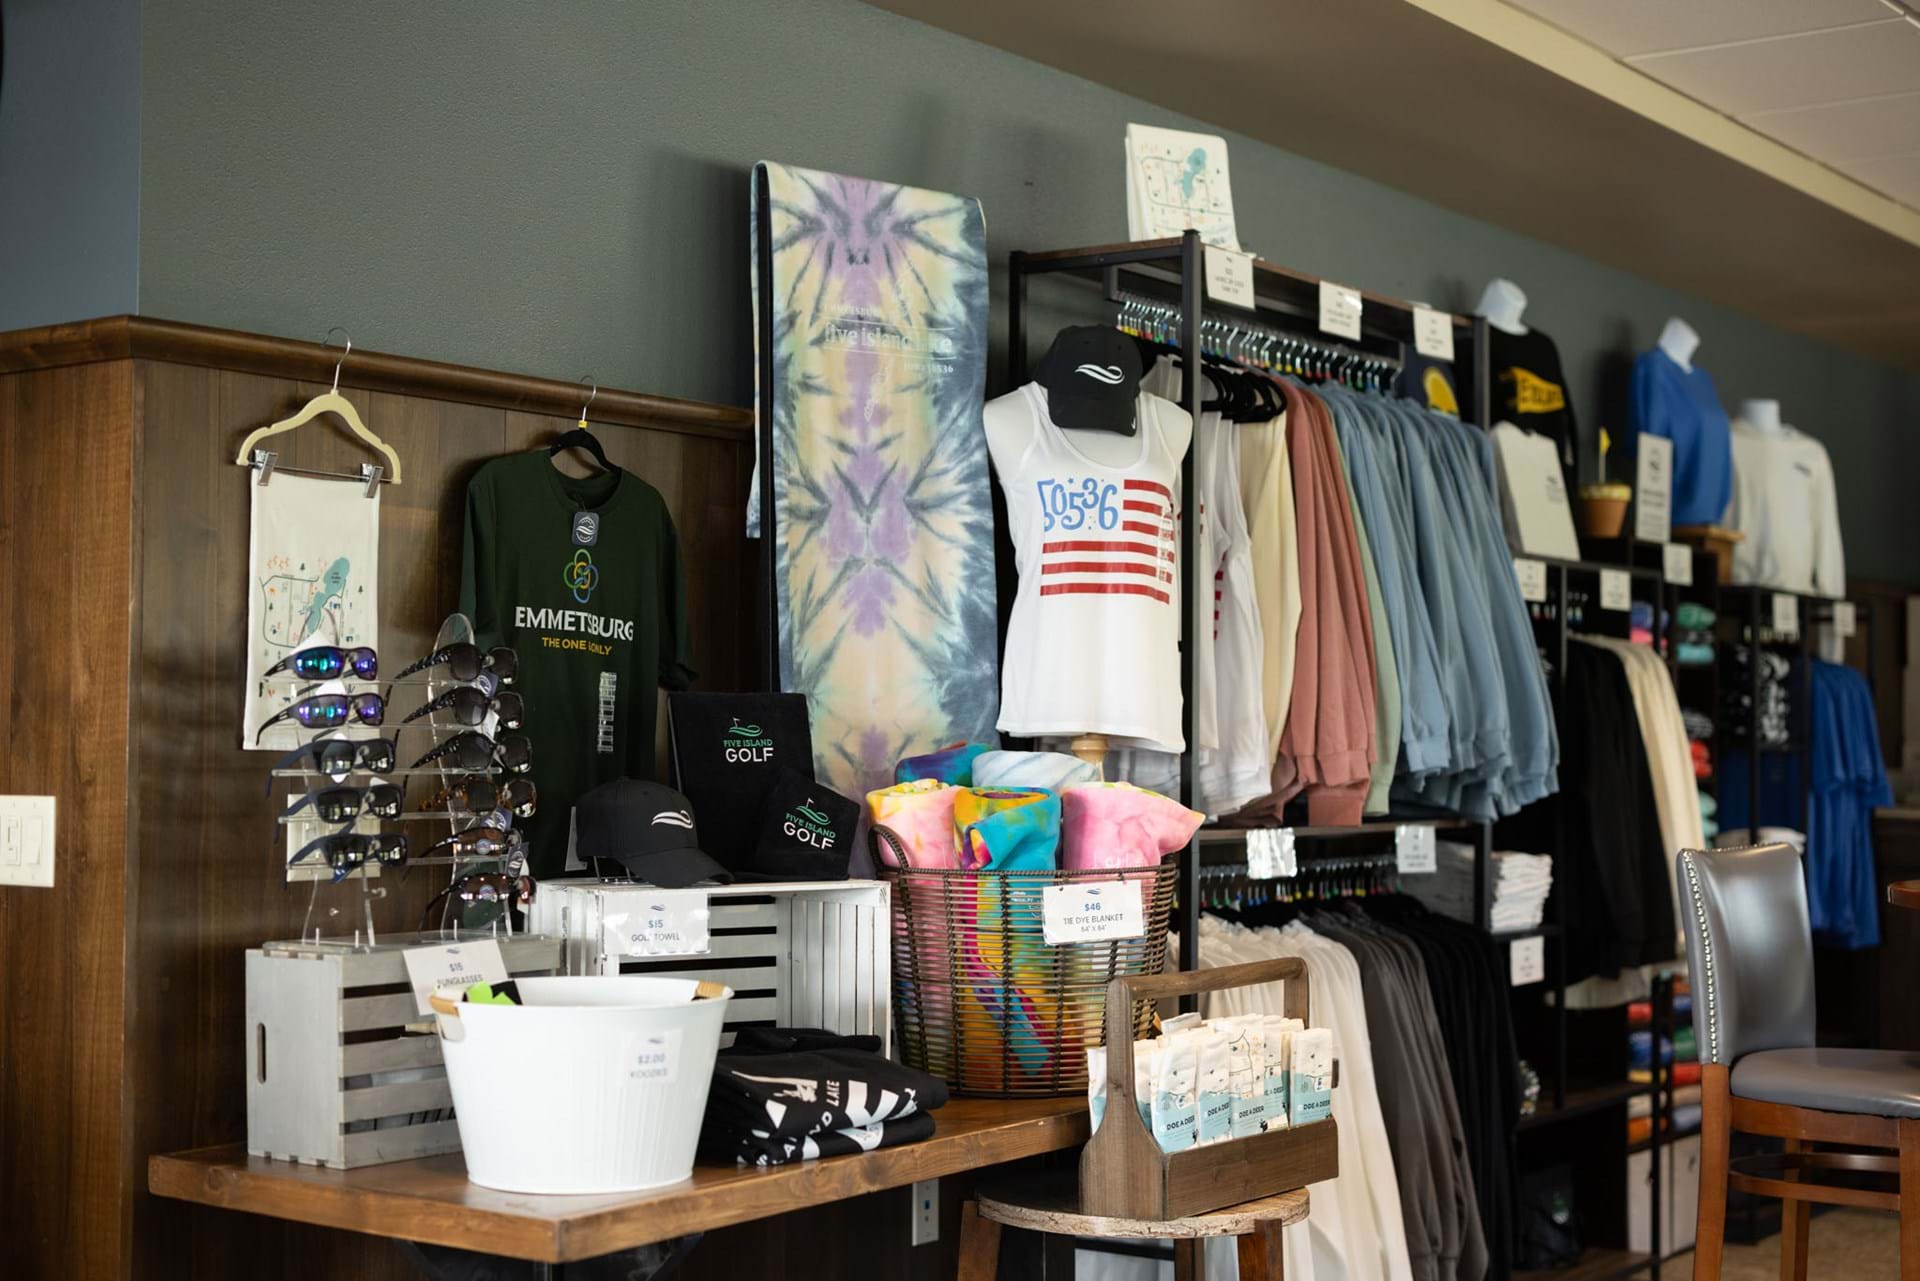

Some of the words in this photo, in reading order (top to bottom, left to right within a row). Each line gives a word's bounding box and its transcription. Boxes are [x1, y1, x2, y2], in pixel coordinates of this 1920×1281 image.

[824, 321, 859, 348] five
[514, 606, 634, 641] EMMETSBURG
[541, 637, 561, 649] THE
[561, 638, 587, 651] ONE
[723, 739, 742, 748] FIVE
[742, 738, 773, 747] ISLAND
[725, 747, 774, 763] GOLF
[785, 813, 804, 826] FIVE
[805, 821, 836, 839] ISLAND
[783, 821, 835, 850] GOLF
[1084, 902, 1101, 912] $46
[1063, 916, 1074, 925] TIE
[1076, 915, 1090, 924] DYE
[1091, 913, 1123, 923] BLANKET
[631, 934, 652, 942] GOL
[654, 933, 680, 941] TOWEL
[826, 1079, 840, 1107] LAKE
